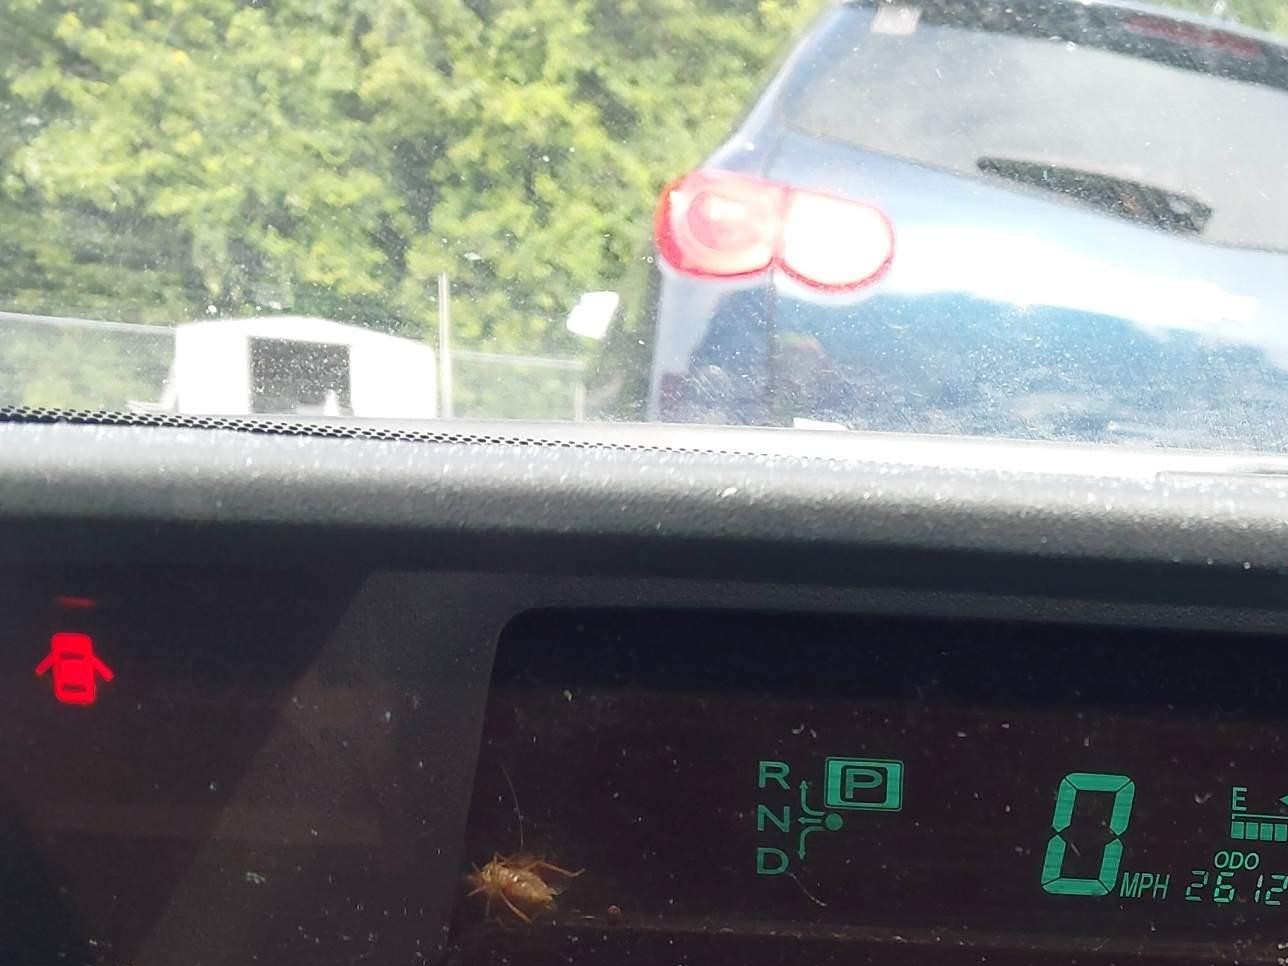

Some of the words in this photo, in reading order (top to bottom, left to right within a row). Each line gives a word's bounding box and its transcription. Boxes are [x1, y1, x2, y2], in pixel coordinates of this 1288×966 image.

[758, 761, 790, 790] R
[845, 768, 883, 799] P
[1232, 786, 1248, 811] E
[757, 804, 791, 832] N
[1041, 772, 1135, 896] 0
[1119, 872, 1170, 899] MPH
[756, 847, 789, 875] D
[1214, 851, 1259, 870] ODO
